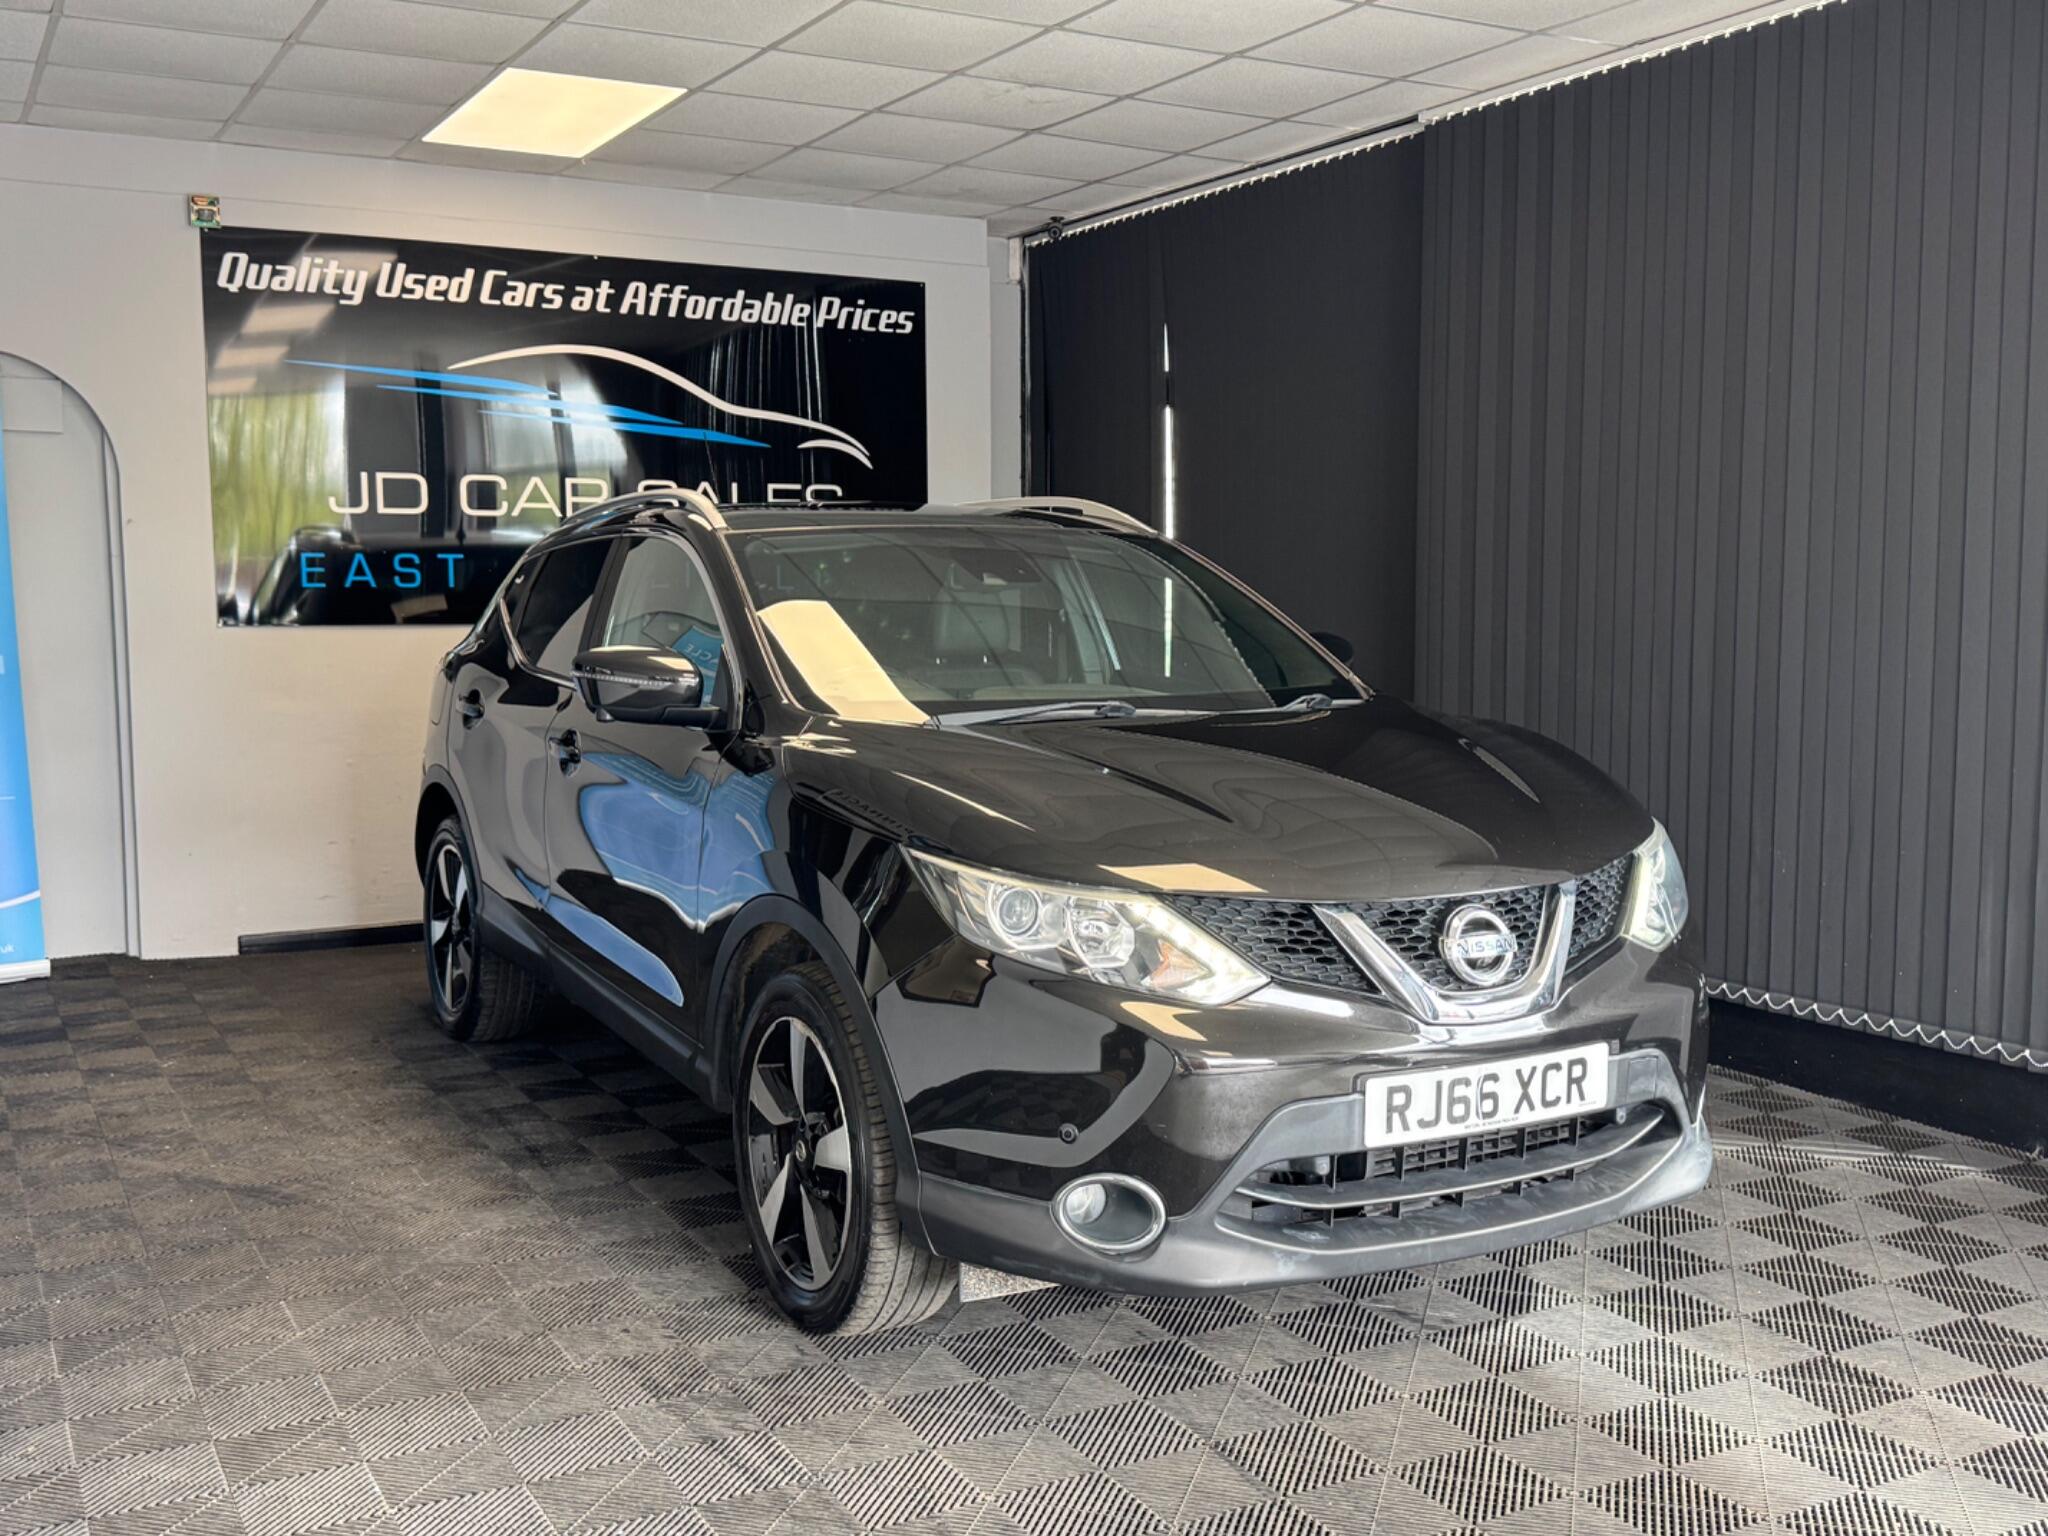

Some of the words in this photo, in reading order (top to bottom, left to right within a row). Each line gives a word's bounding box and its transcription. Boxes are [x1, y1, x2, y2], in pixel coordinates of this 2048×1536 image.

[217, 251, 368, 306] Quality
[375, 261, 475, 303] Used
[479, 270, 565, 309] Cars
[570, 279, 615, 313] at
[619, 281, 811, 327] Affordable
[816, 296, 915, 334] Prices
[328, 471, 429, 514] JD
[300, 552, 465, 588] EAST
[1457, 937, 1515, 957] NISSAN
[1385, 1073, 1499, 1134] RJ66
[1514, 1057, 1588, 1114] XCR
